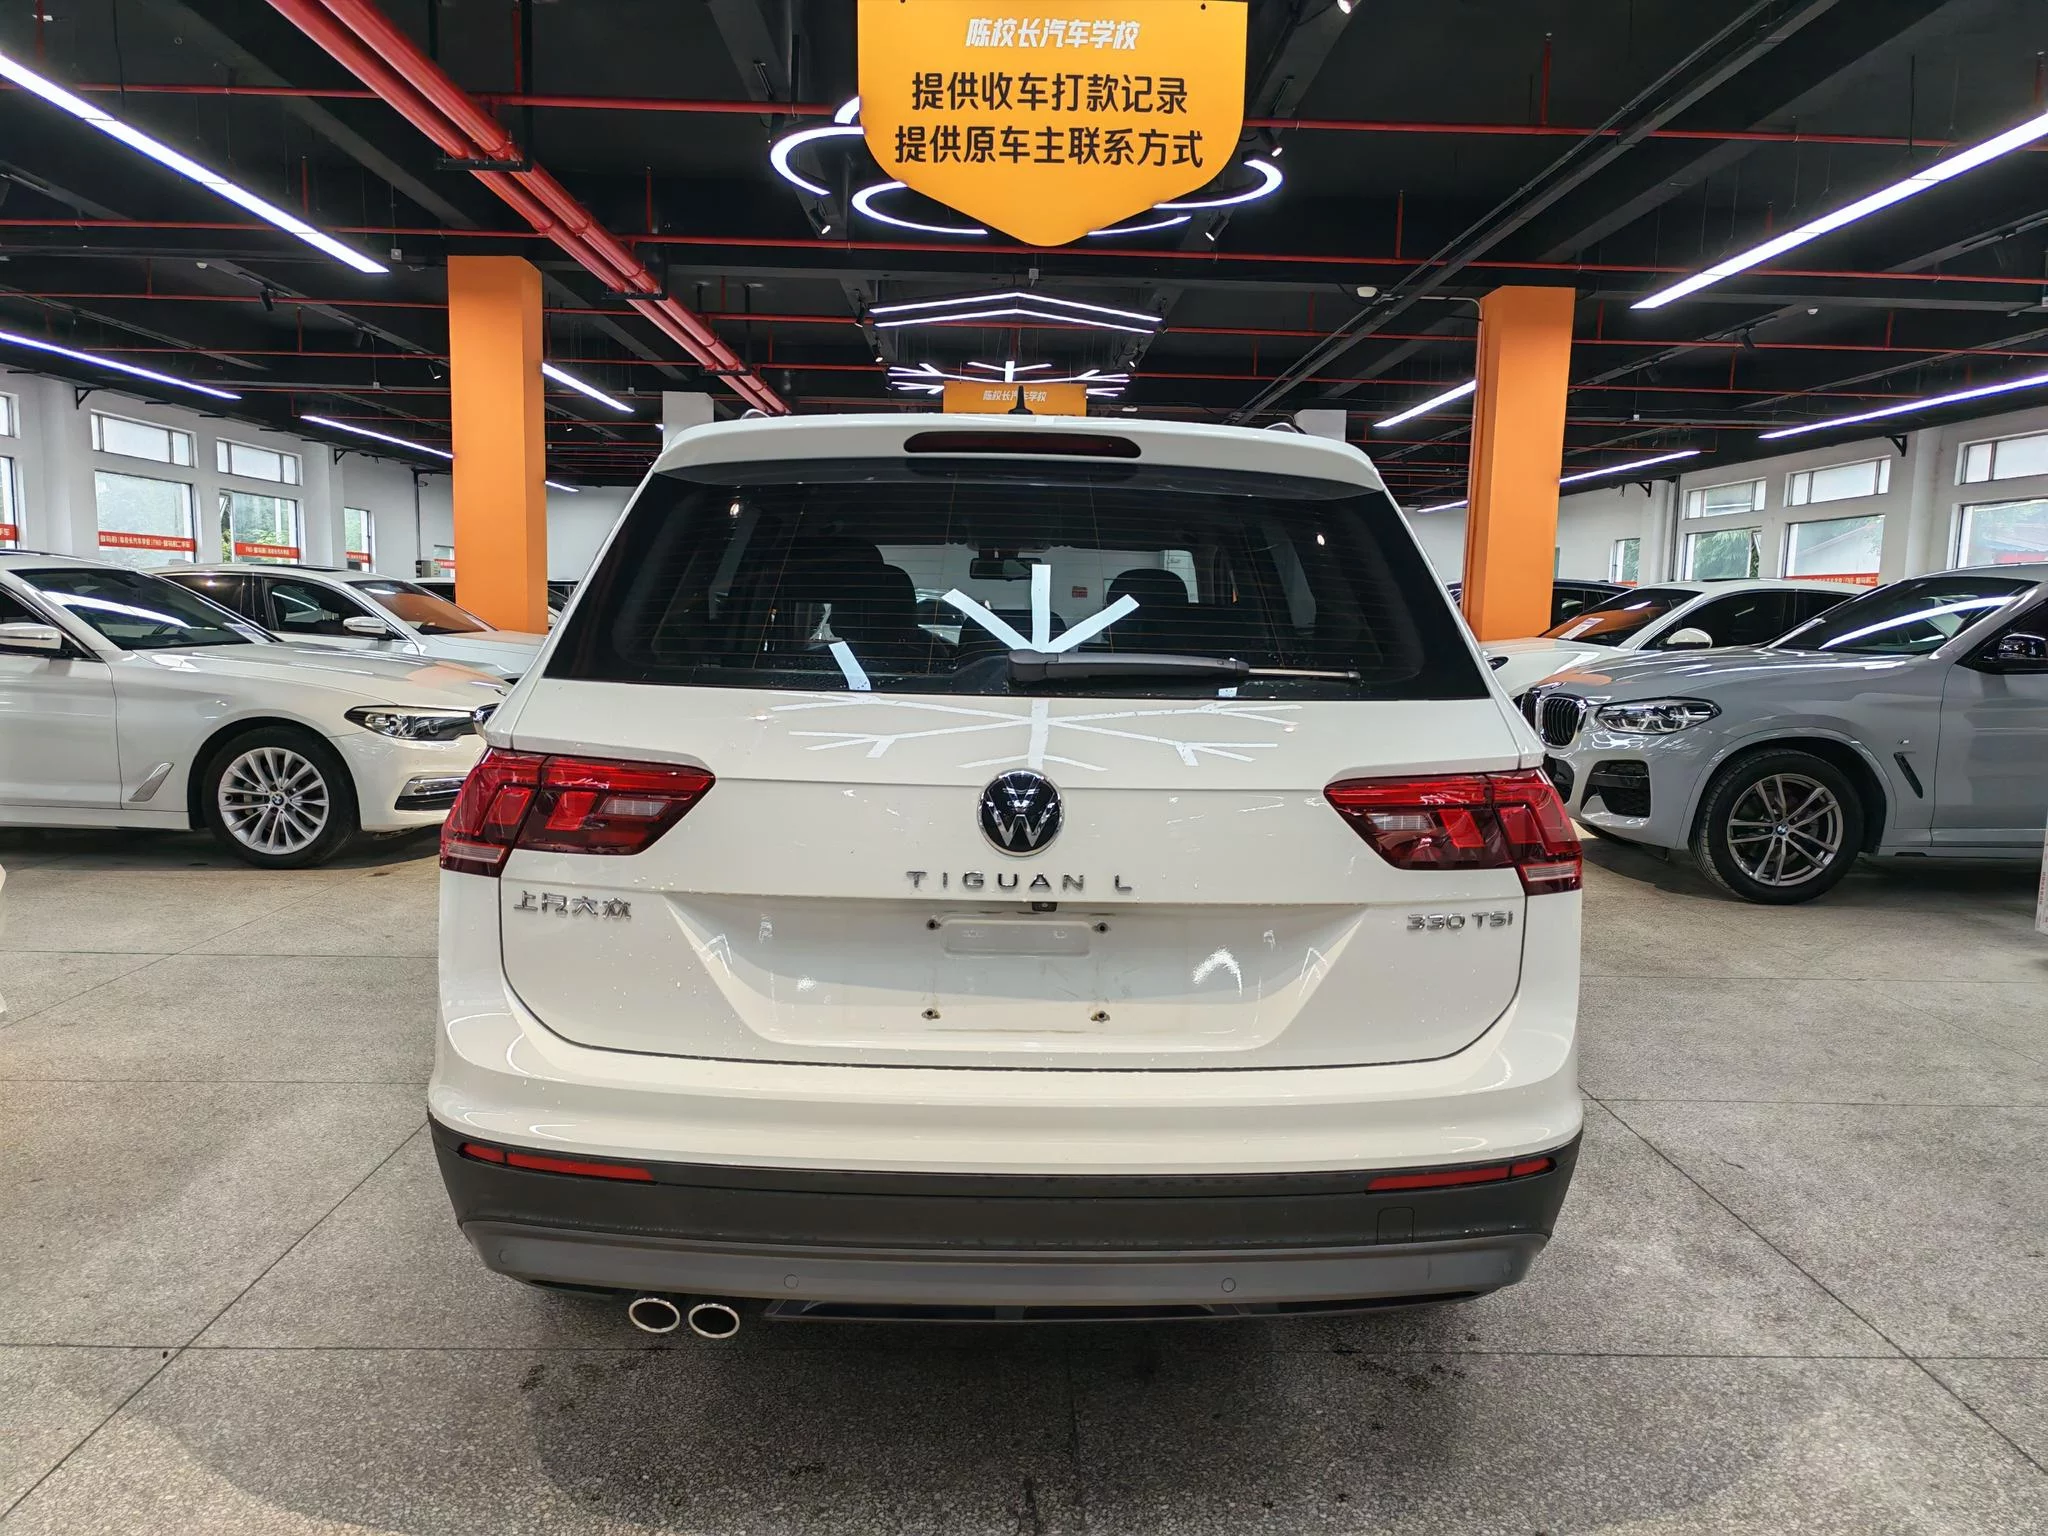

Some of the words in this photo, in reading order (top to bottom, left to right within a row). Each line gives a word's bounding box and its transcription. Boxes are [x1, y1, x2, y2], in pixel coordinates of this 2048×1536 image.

[965, 17, 1140, 50] 陈校长汽车学校
[912, 71, 1188, 114] 提供收车打款记录
[894, 125, 1203, 168] 提供原车主联系方式
[906, 871, 1084, 891] TIGUAN
[1115, 874, 1133, 892] L
[1406, 913, 1466, 930] 330
[1471, 910, 1514, 929] TSI
